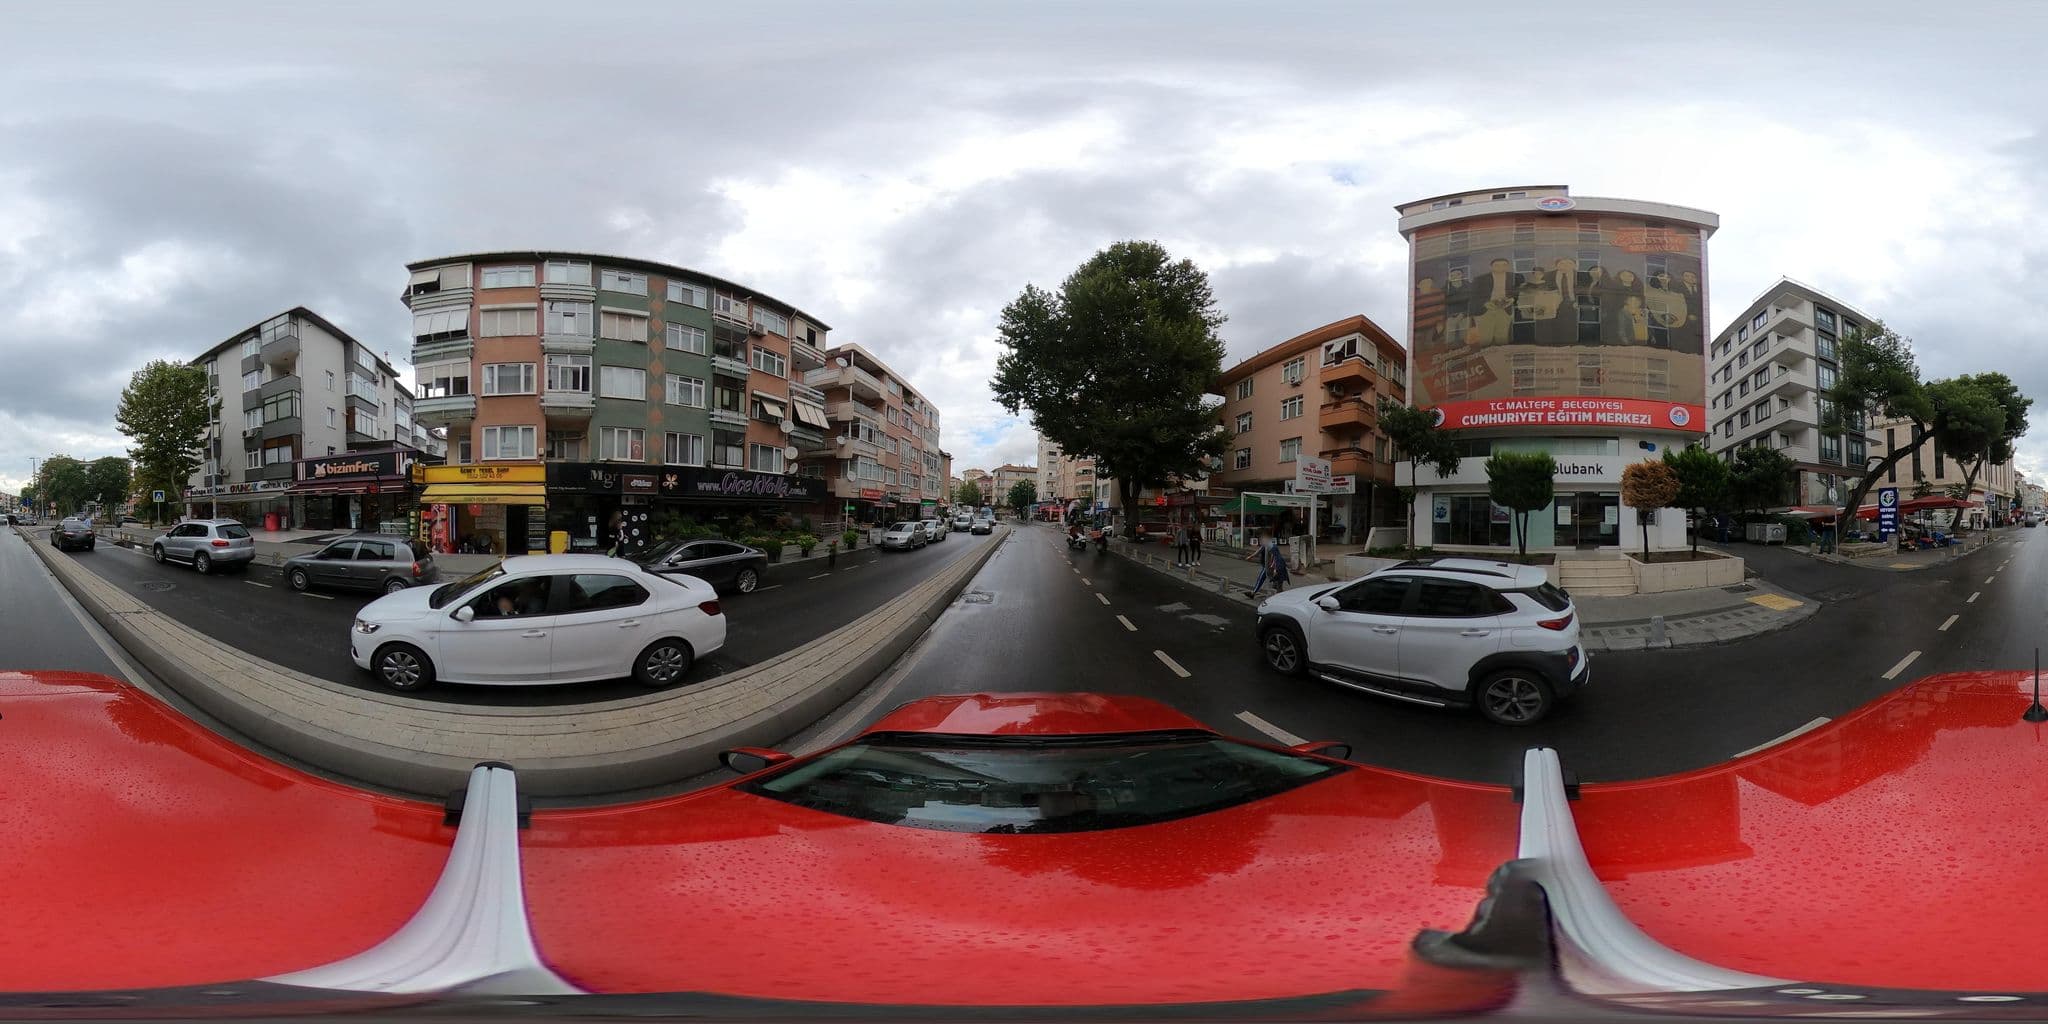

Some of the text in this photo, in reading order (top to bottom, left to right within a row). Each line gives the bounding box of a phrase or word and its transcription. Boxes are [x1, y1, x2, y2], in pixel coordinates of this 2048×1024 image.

[1506, 400, 1555, 410] MALTEPE
[1562, 400, 1623, 411] BELEDİYESİ
[1461, 409, 1652, 426] CUMHURİYET EĞİTİM MERKEZİ
